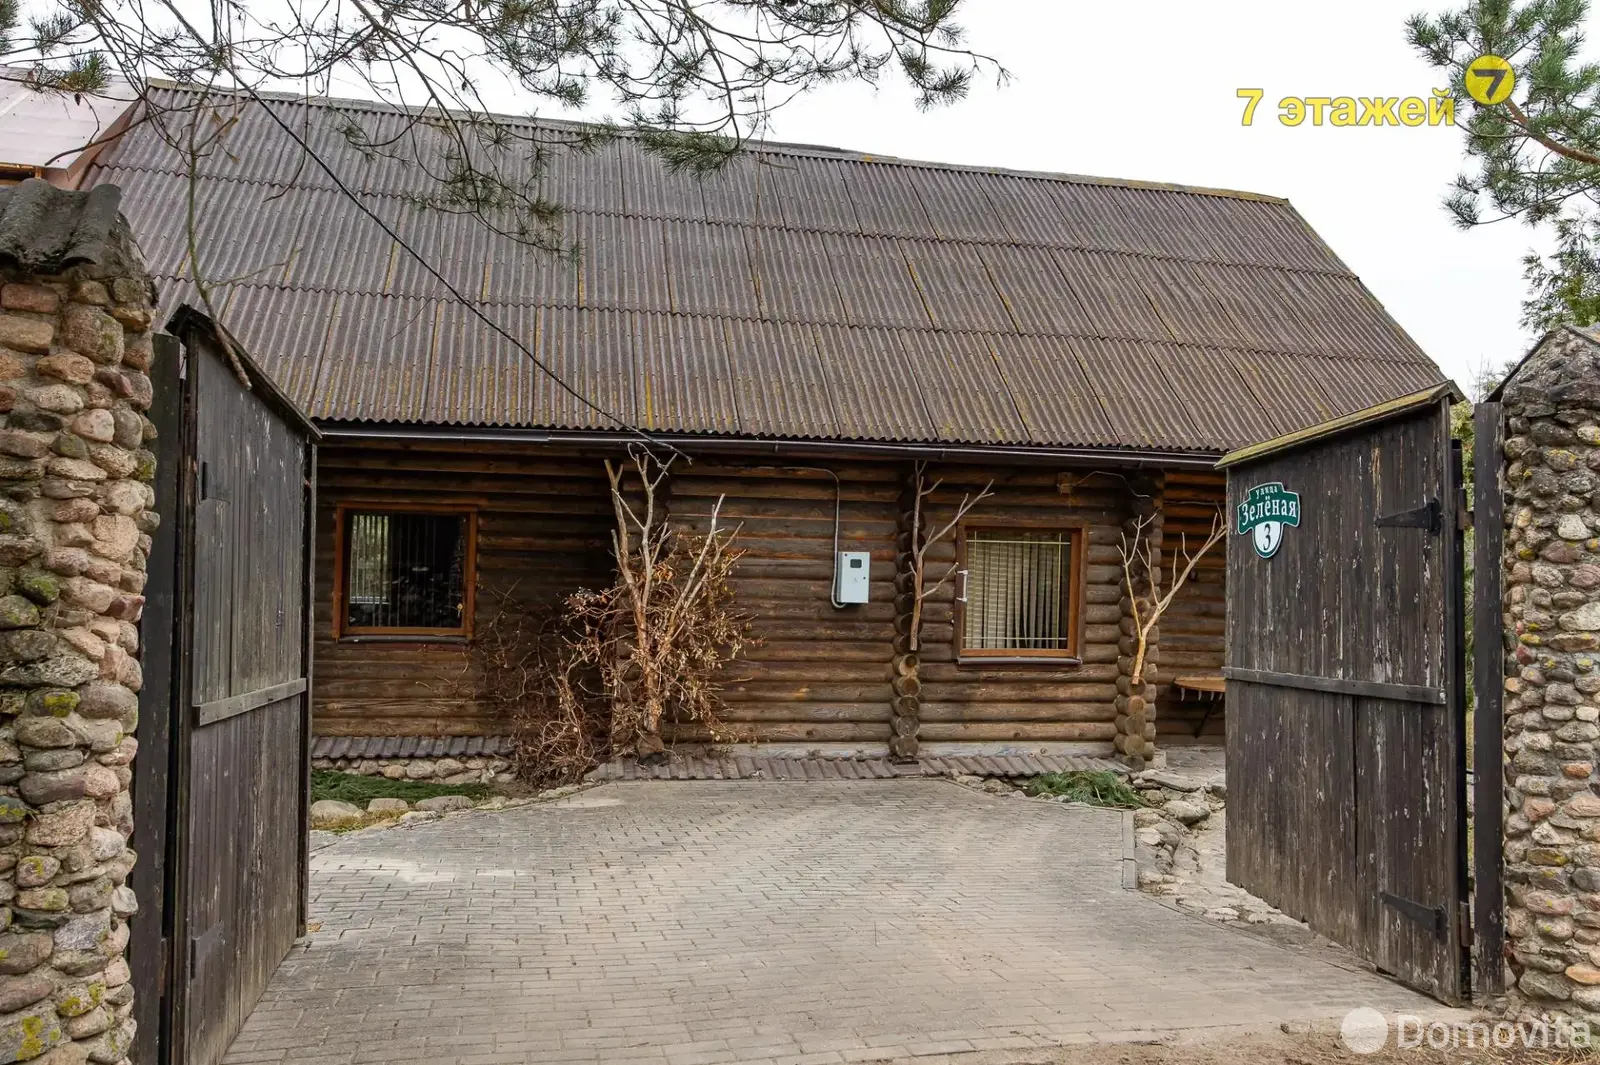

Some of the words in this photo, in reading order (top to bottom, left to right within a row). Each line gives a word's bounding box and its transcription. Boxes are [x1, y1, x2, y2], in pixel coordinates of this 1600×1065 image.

[1255, 485, 1278, 499] улица
[1241, 496, 1297, 526] Зелёная
[1263, 523, 1271, 551] 3
